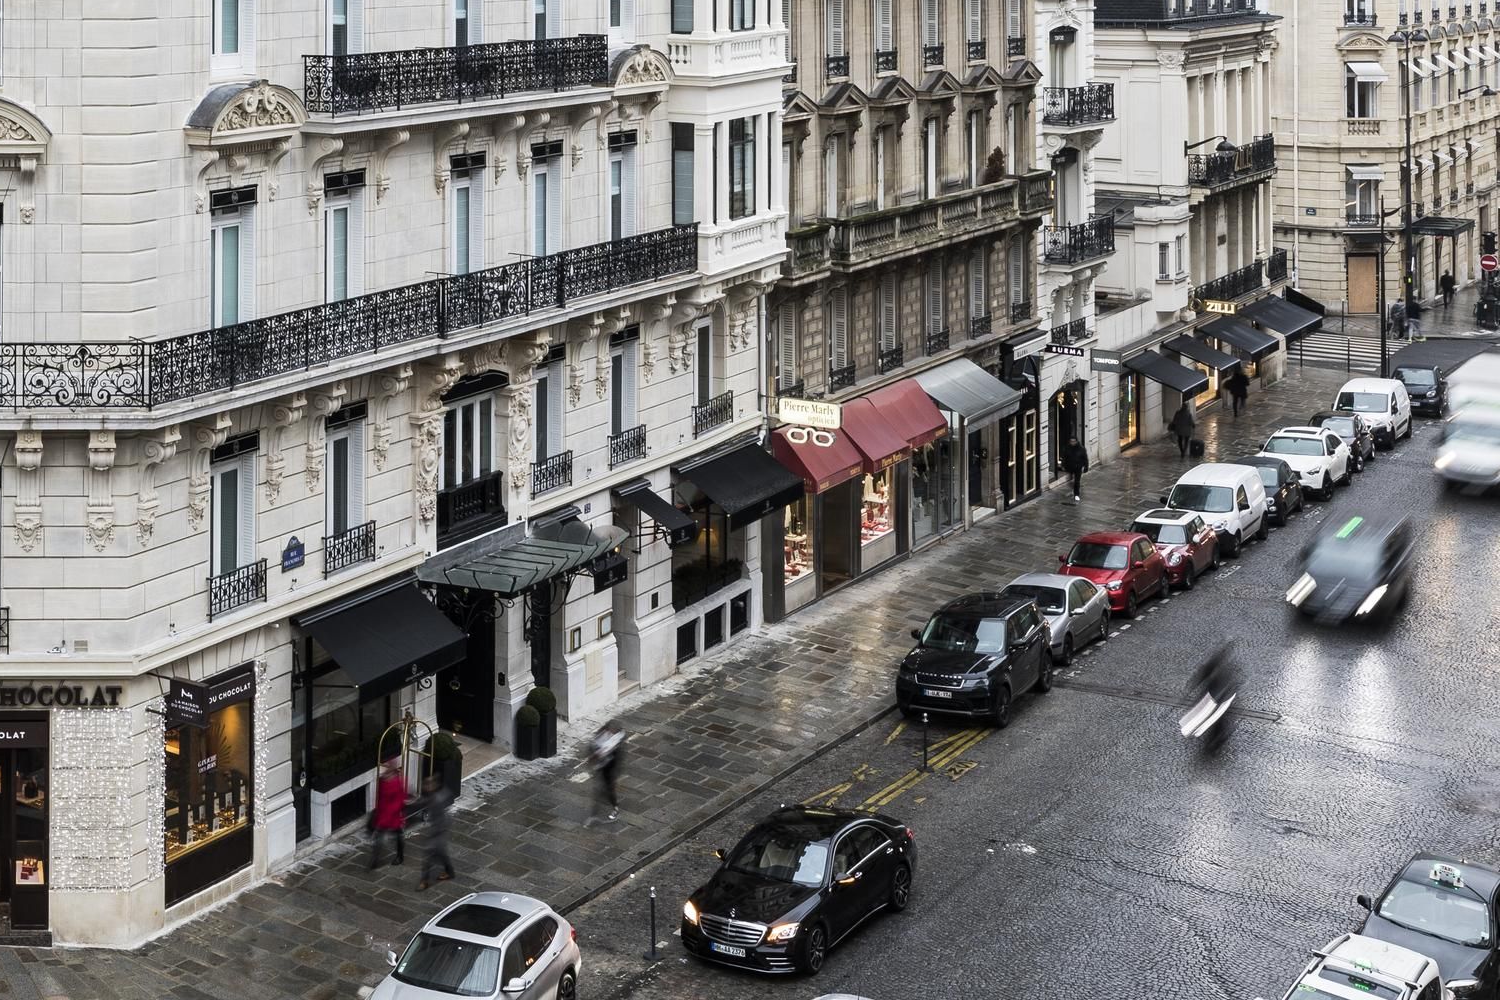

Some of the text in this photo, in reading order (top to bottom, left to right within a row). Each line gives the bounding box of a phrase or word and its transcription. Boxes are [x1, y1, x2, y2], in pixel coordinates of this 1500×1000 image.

[1206, 302, 1236, 315] ZILLI
[1052, 346, 1082, 355] BURMA
[784, 400, 834, 416] Pierre Marly
[218, 682, 251, 700] CHOCOLAT
